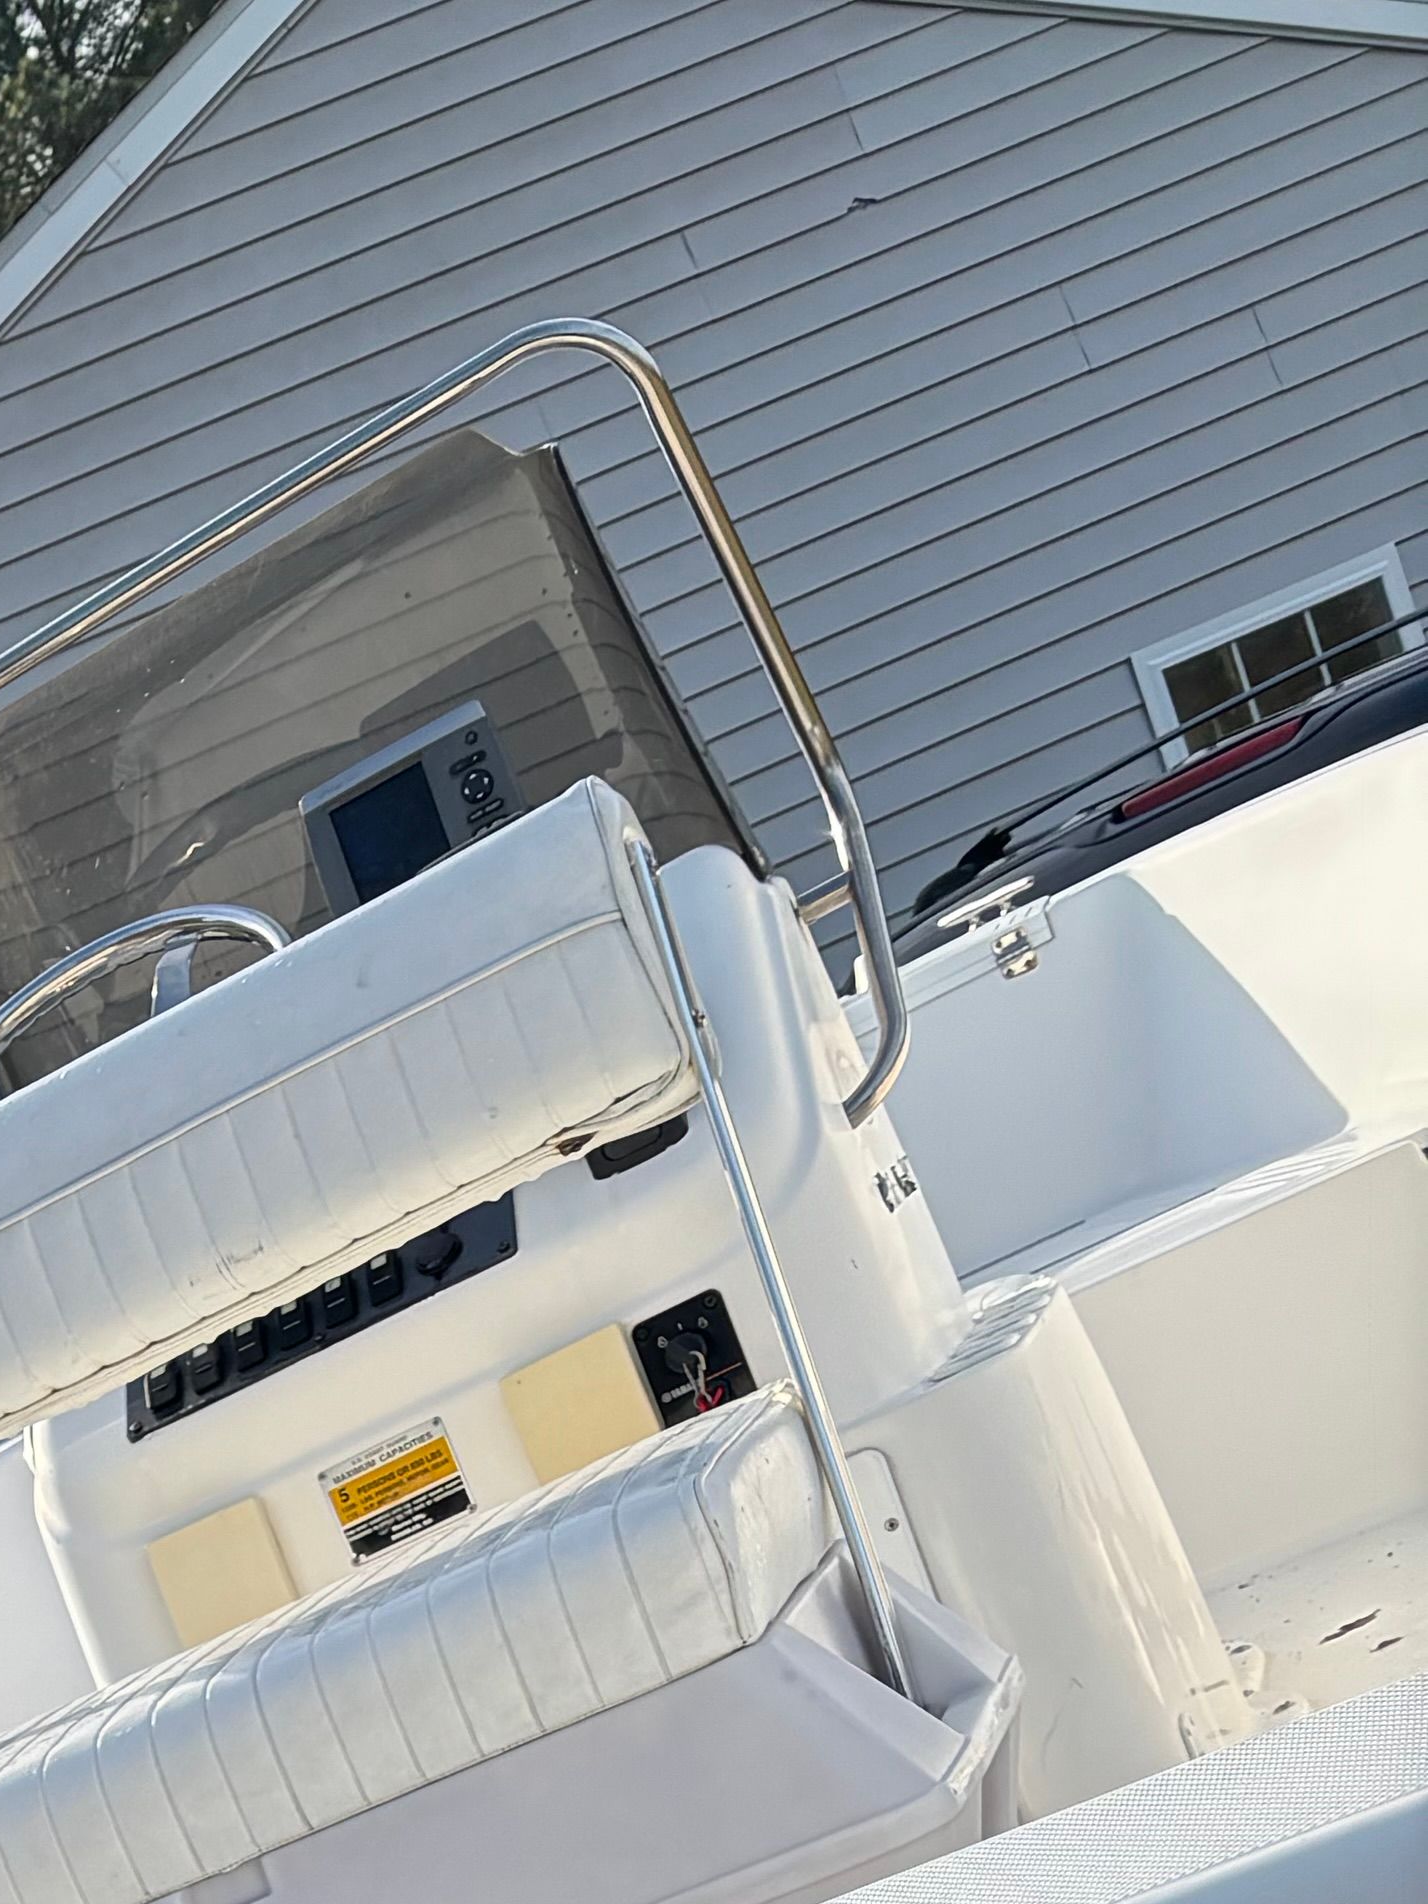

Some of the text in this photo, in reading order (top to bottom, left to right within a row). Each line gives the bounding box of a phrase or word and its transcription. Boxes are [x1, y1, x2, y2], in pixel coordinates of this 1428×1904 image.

[332, 1460, 377, 1485] MAXIMUM
[379, 1431, 433, 1463] CAPACITIES
[338, 1487, 350, 1503] 5
